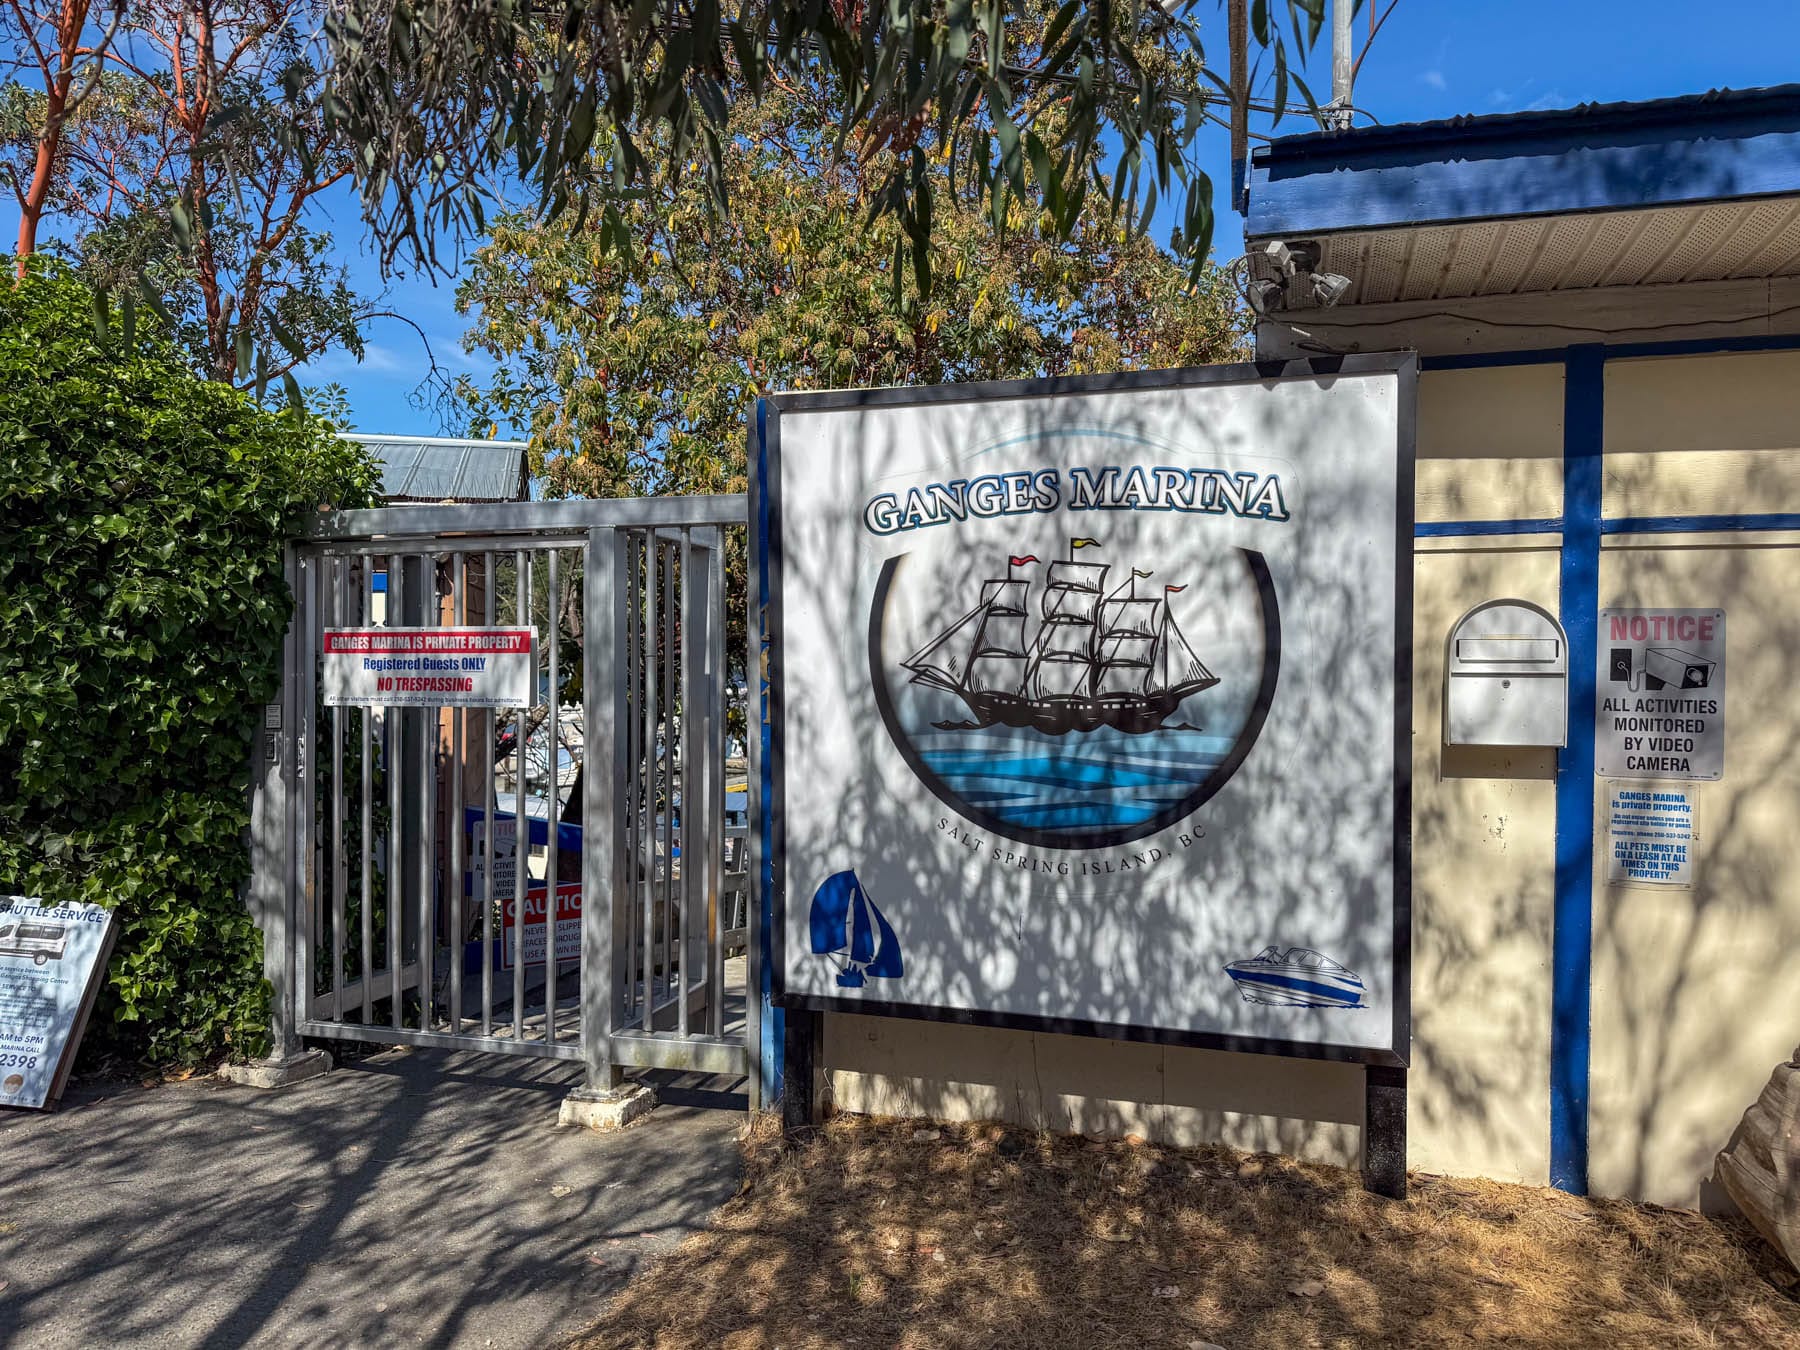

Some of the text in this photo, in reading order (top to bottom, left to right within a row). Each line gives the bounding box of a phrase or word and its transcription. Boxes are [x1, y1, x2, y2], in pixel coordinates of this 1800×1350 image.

[864, 465, 1290, 536] GANGES MARINA
[1610, 615, 1714, 641] NOTICE
[331, 635, 521, 650] GANGES MARINA IS PRIVATE PROPERTY
[363, 657, 486, 672] Registered Guests ONLY
[377, 677, 473, 692] NO TRESPASSING
[1602, 697, 1717, 714] ALL ACTIVITIES
[1614, 717, 1705, 733] MONITORED
[1624, 736, 1694, 753] BY VIDEO
[1627, 756, 1690, 772] CAMERA
[1619, 791, 1686, 803] GANGES MARINA
[1612, 800, 1692, 813] is private property.
[937, 817, 1207, 876] SALT SPRING ISLAND, BC
[1615, 841, 1687, 854] ALL PETS MUST BE
[1615, 850, 1686, 863] ON A LEASH AT ALL
[1621, 860, 1680, 872] TIMES ON THIS
[1628, 868, 1672, 880] PROPERTY.
[507, 893, 582, 918] CAUTIO
[52, 908, 105, 923] SERVICE
[26, 1046, 40, 1054] CALL
